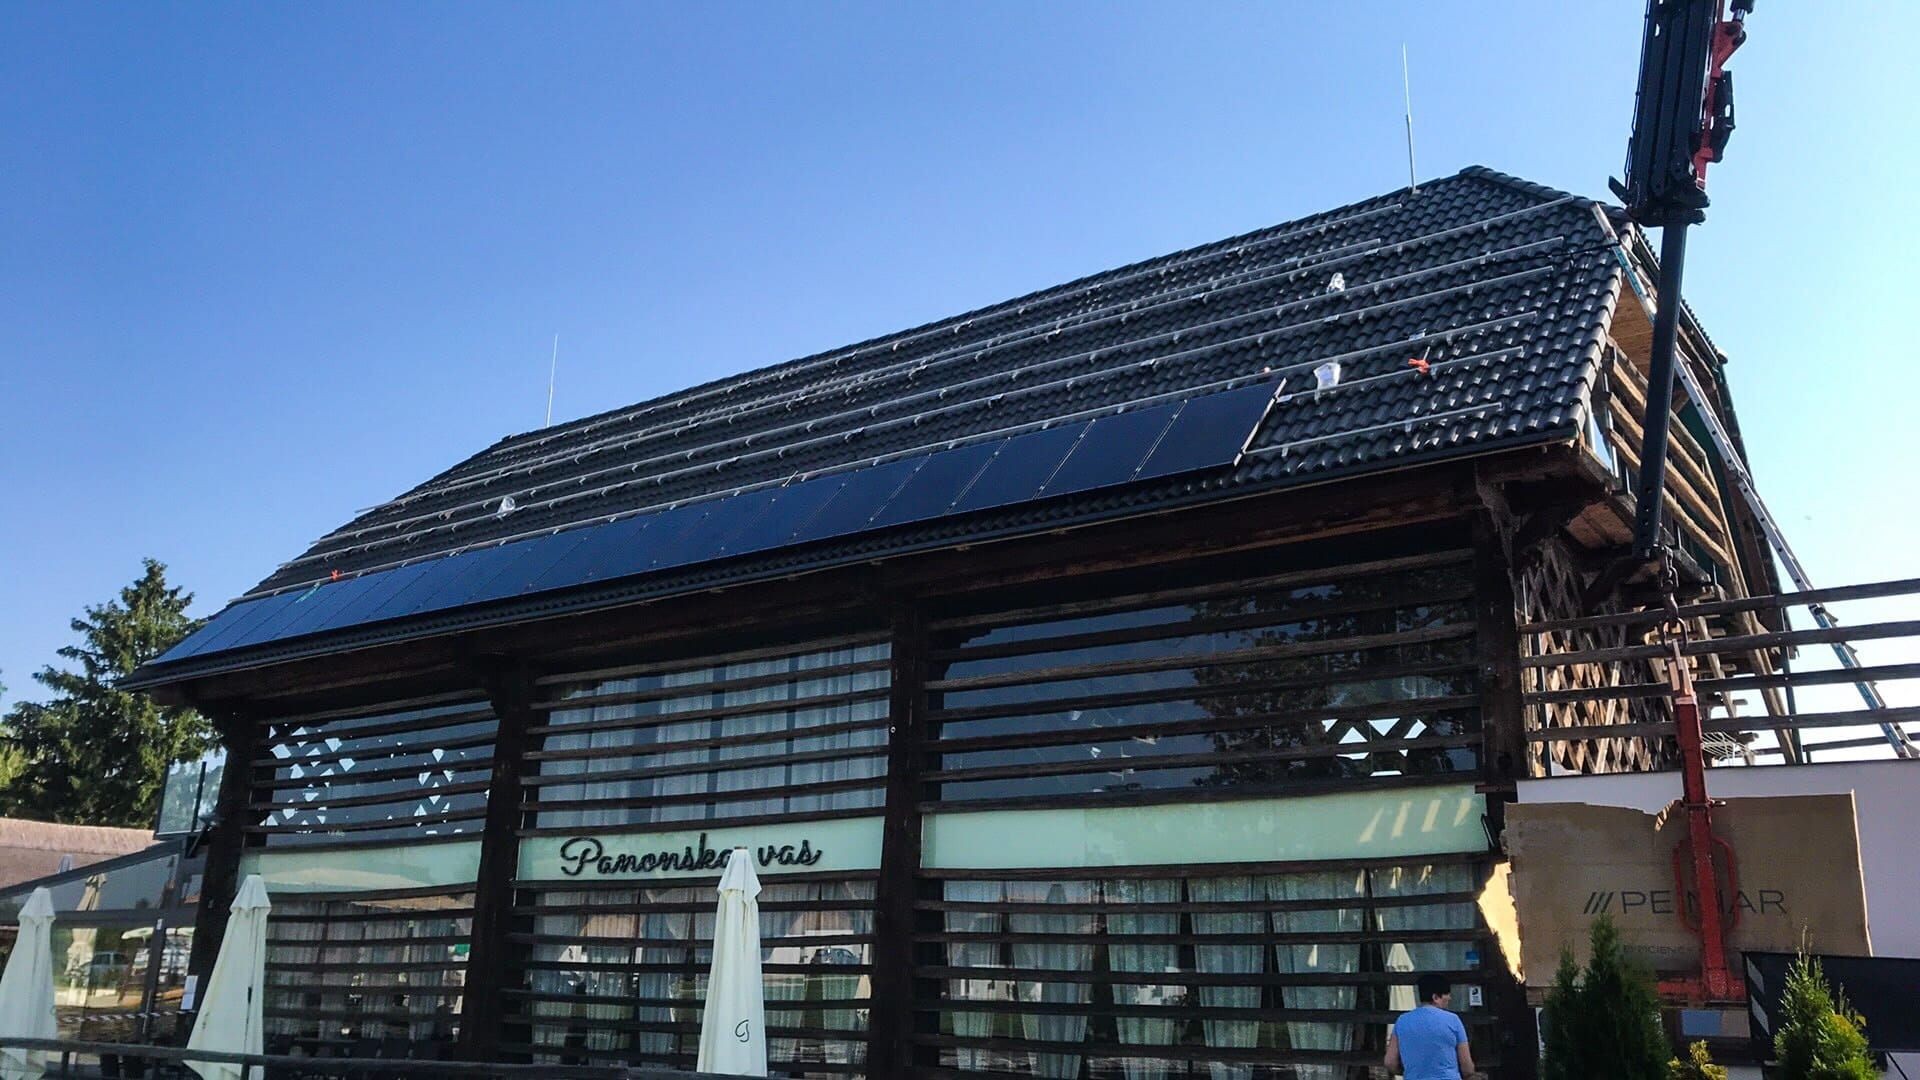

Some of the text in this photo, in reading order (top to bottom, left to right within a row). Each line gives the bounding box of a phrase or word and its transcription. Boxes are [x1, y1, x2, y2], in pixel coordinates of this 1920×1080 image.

[560, 832, 822, 876] Panonska vas
[1621, 889, 1788, 914] PEMAR
